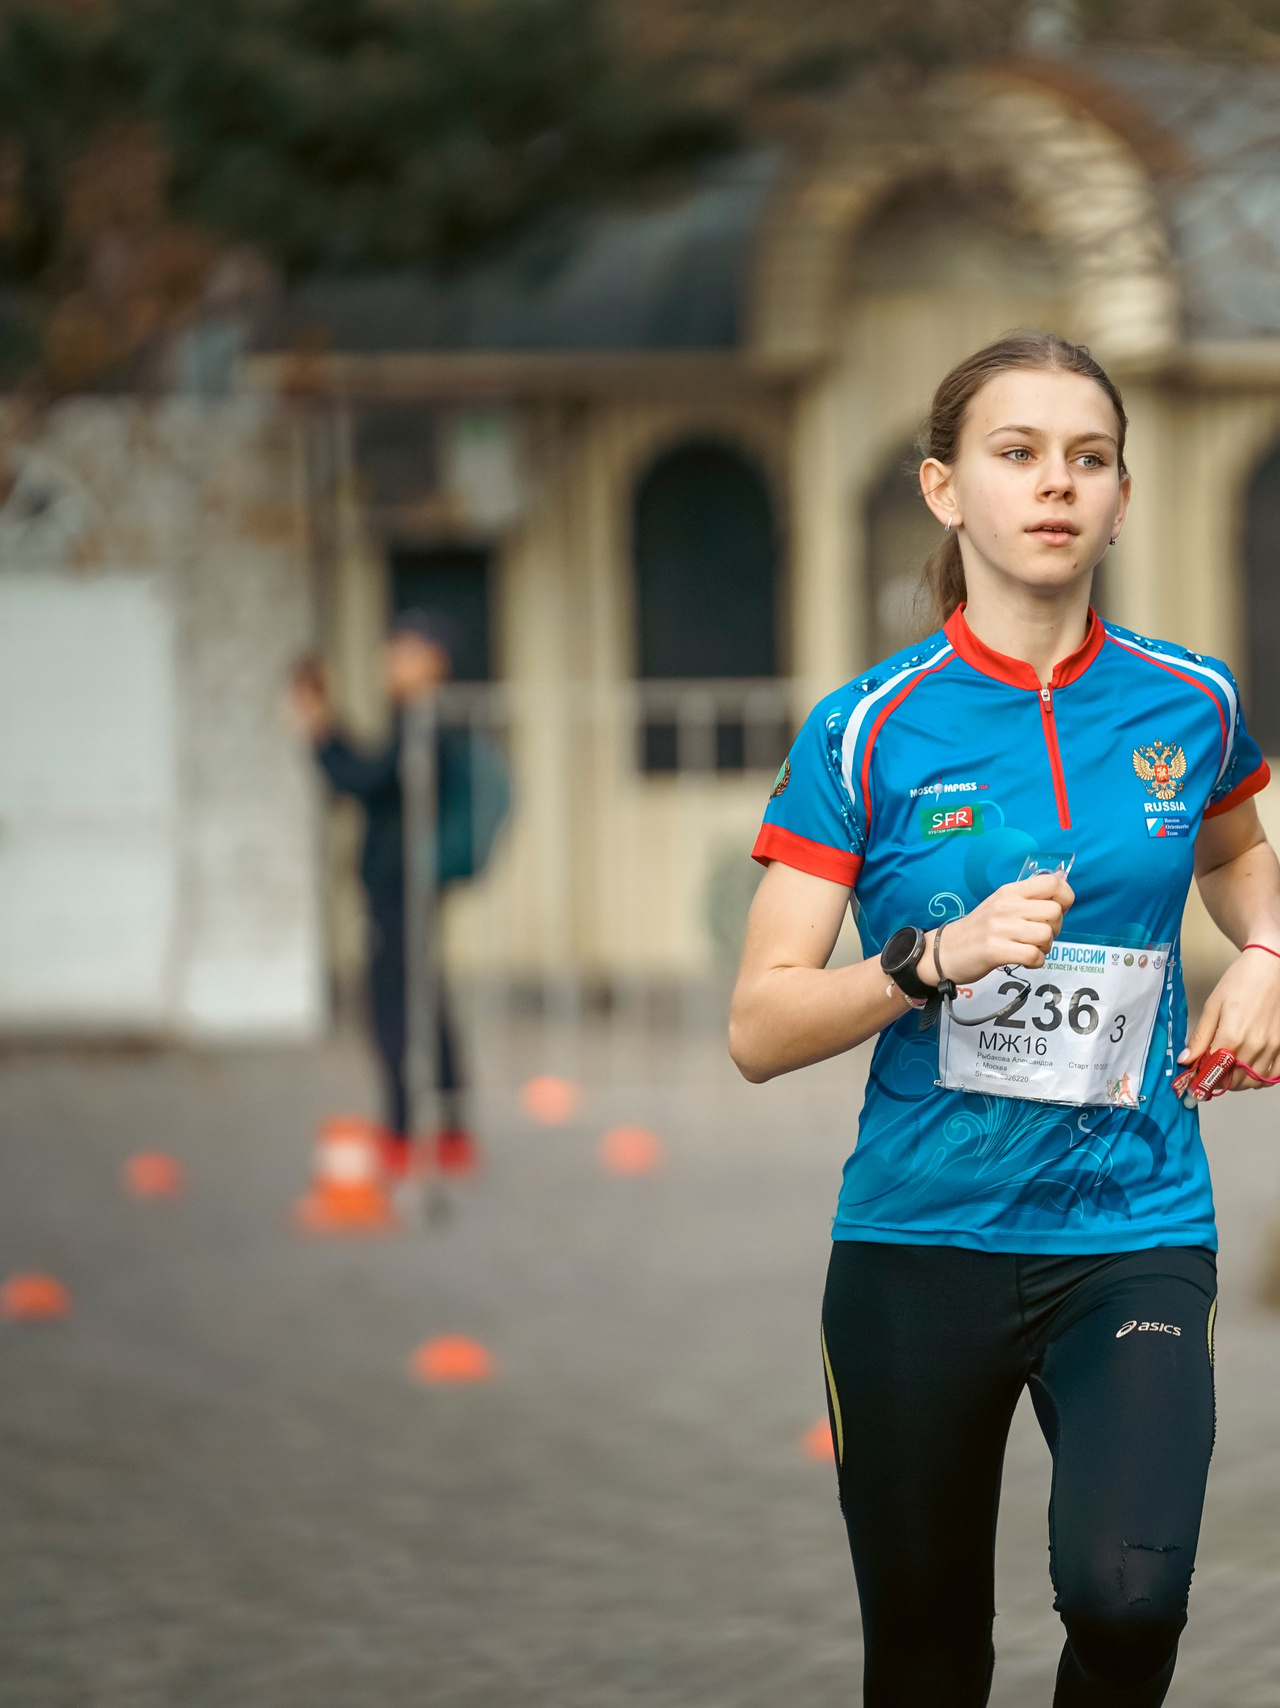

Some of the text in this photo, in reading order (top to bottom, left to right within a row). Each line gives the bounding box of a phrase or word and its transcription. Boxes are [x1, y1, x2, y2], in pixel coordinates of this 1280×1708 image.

[1144, 801, 1187, 813] RUSSIA
[932, 811, 968, 828] SFR
[1062, 947, 1106, 965] РОССИИ
[994, 981, 1100, 1035] 236
[1110, 1014, 1126, 1043] 3
[979, 1031, 1048, 1056] МЖ16
[977, 1051, 1011, 1062] Рыбакова
[983, 1061, 1008, 1071] Москва
[1068, 1061, 1089, 1070] Старт
[1138, 1322, 1182, 1336] asics
